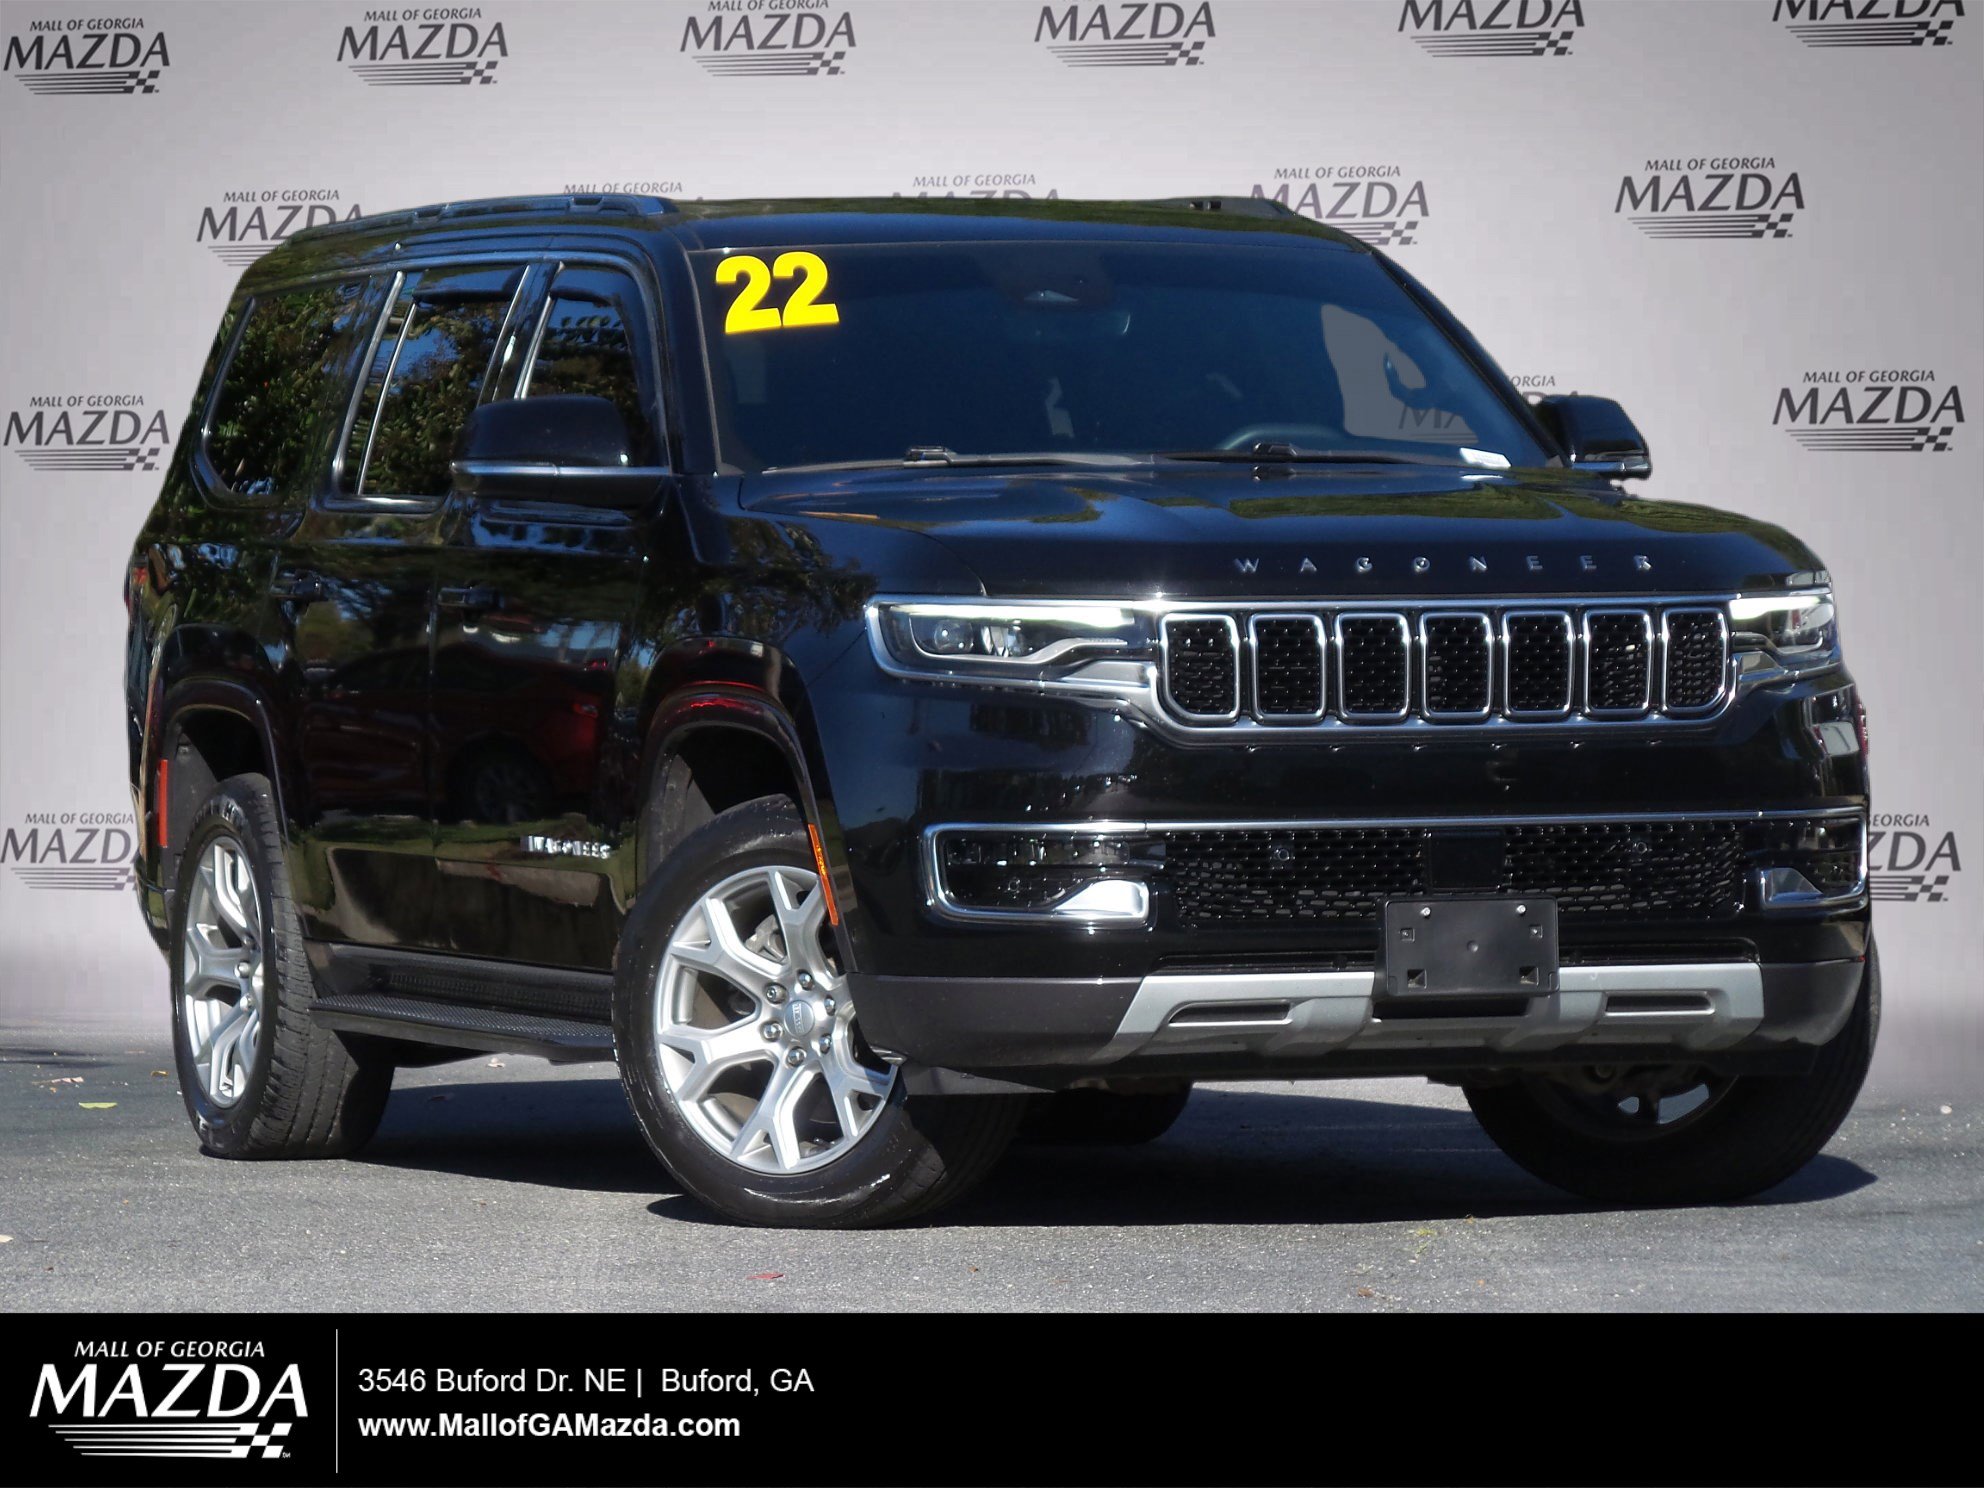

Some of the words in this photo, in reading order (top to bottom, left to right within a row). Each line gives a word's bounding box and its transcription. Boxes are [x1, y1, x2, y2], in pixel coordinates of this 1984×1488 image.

[708, 0, 742, 11] MALL
[746, 0, 767, 10] OF
[768, 0, 829, 10] GEORGIA
[364, 10, 398, 21] MALL
[402, 10, 421, 21] OF
[423, 8, 482, 20] GEORGIA
[1034, 0, 1216, 42] MAZDA
[1398, 0, 1585, 32] MAZDA
[30, 20, 64, 31] MALL
[67, 19, 85, 31] OF
[86, 18, 145, 30] GEORGIA
[680, 11, 857, 52] MAZDA
[337, 22, 509, 62] MAZDA
[3, 31, 171, 71] MAZDA
[1645, 159, 1682, 171] MALL
[1687, 159, 1706, 171] OF
[1711, 158, 1776, 170] GEORGIA
[1274, 168, 1311, 179] MALL
[1315, 167, 1334, 179] OF
[1337, 166, 1401, 178] GEORGIA
[913, 176, 947, 187] MALL
[953, 175, 970, 187] OF
[974, 174, 1036, 186] GEORGIA
[564, 184, 597, 194] MALL
[602, 183, 620, 193] OF
[623, 182, 683, 193] GEORGIA
[1615, 172, 1805, 212] MAZDA
[223, 191, 256, 202] MALL
[261, 190, 279, 202] OF
[282, 189, 340, 201] GEORGIA
[716, 251, 840, 334] 22
[1511, 375, 1556, 387] ORGIA
[1802, 371, 1841, 383] MALL
[1846, 370, 1865, 383] OF
[1869, 370, 1936, 382] GEORGIA
[30, 396, 62, 407] MALL
[66, 396, 84, 407] OF
[87, 395, 144, 406] GEORGIA
[1772, 385, 1966, 425] MAZDA
[3, 409, 170, 446] MAZDA
[1234, 555, 1653, 573] WAGONEER
[25, 813, 56, 824] MALL
[60, 812, 76, 824] OF
[79, 812, 134, 824] GEORGIA
[1872, 813, 1930, 827] EORGIA
[0, 828, 139, 864] MAZD
